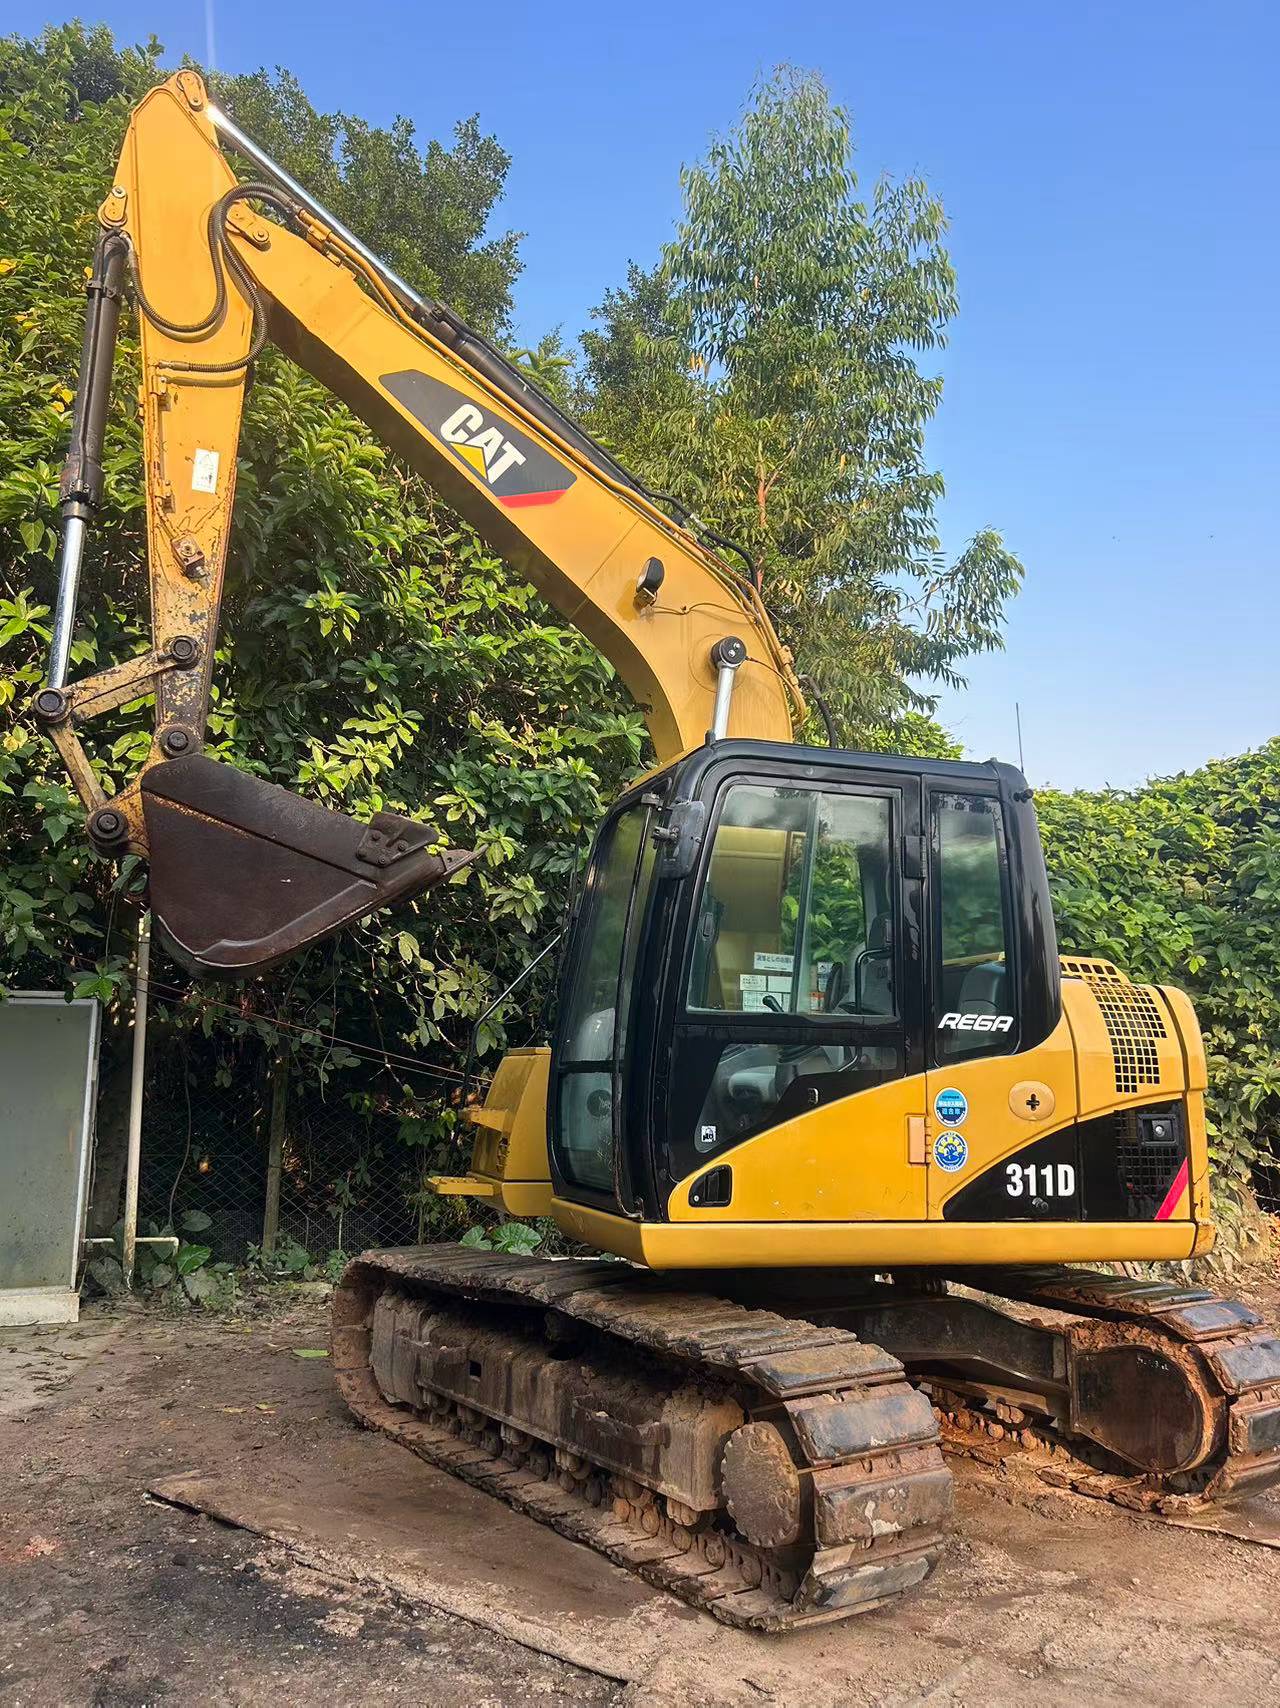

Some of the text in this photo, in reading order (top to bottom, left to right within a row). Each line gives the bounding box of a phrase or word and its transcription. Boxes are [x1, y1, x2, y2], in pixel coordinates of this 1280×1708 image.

[440, 403, 527, 485] CAT
[937, 1012, 1014, 1032] REGA
[1006, 1163, 1075, 1197] 311D
